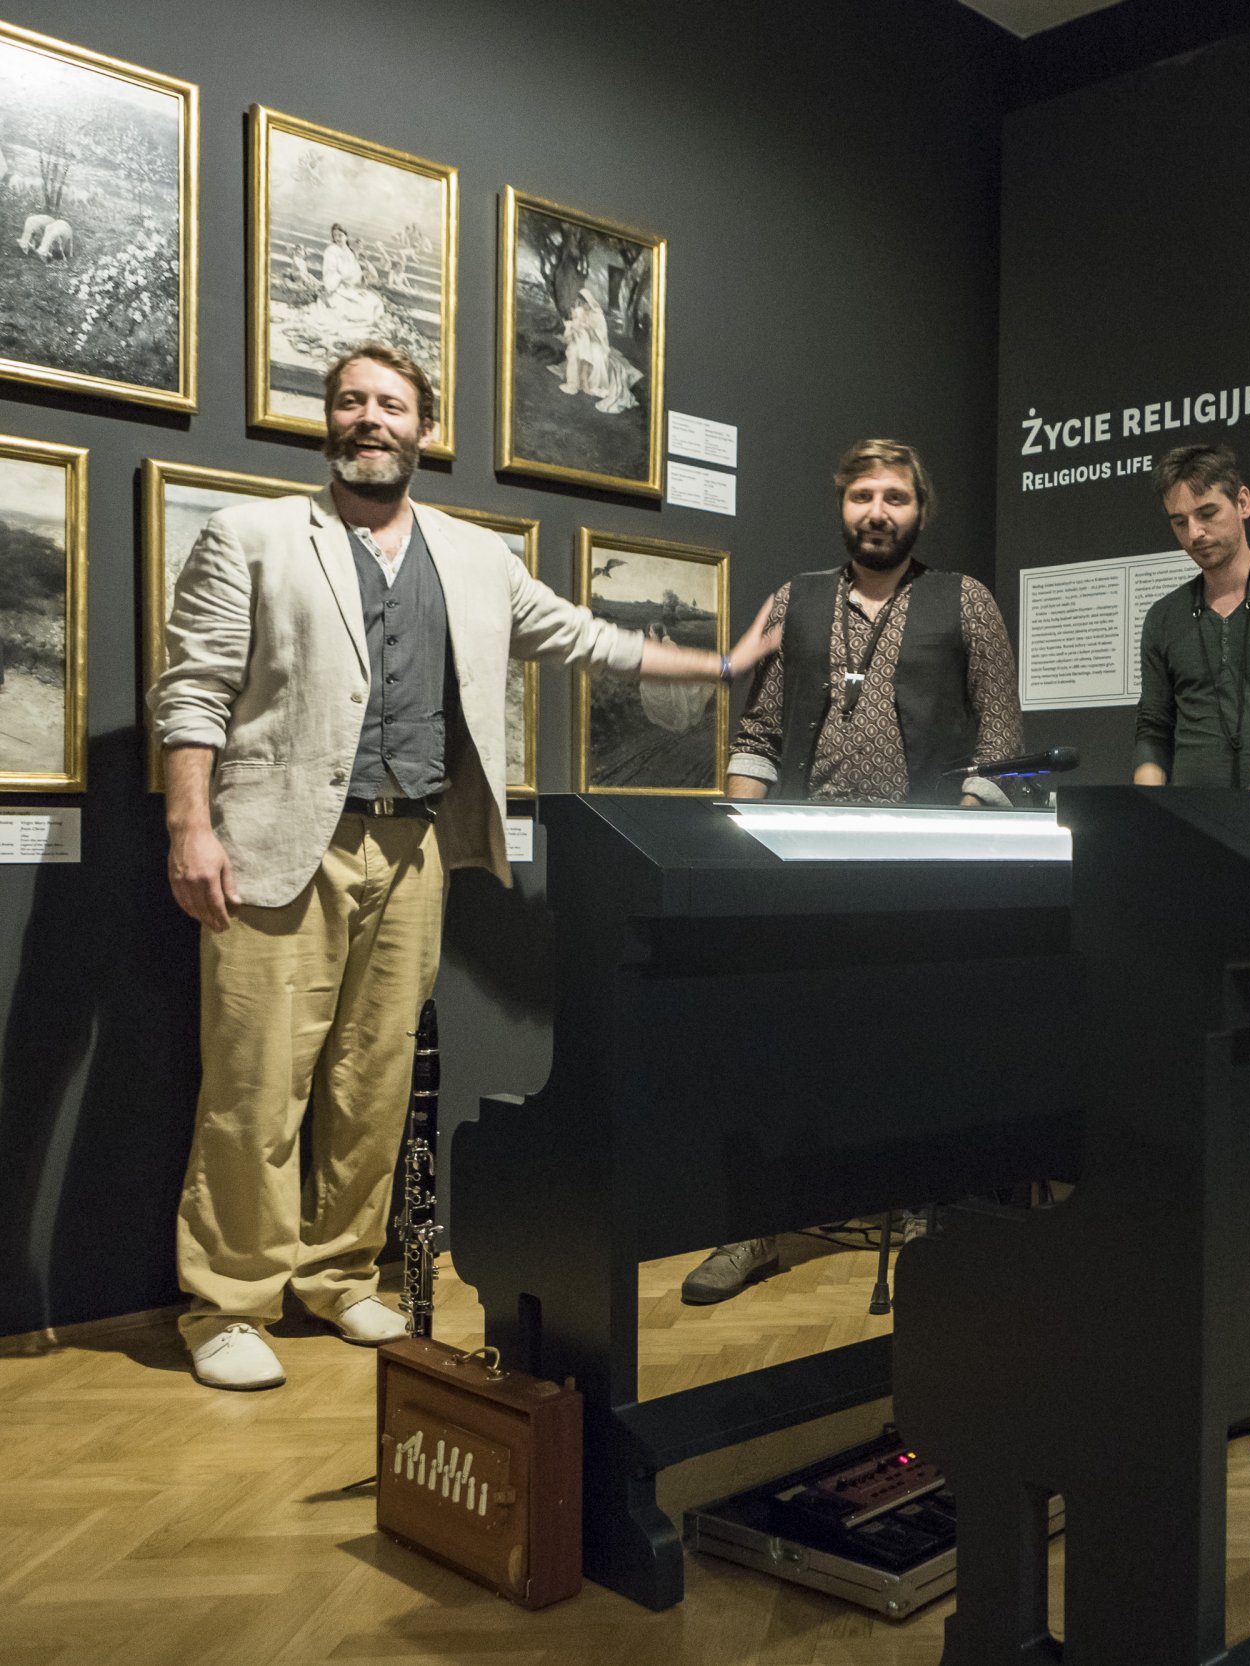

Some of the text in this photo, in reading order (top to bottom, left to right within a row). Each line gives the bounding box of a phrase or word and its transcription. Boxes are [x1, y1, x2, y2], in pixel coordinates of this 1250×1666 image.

[1021, 407, 1112, 455] ŻYCIE
[1022, 455, 1153, 491] RELIGIOUS LIFE
